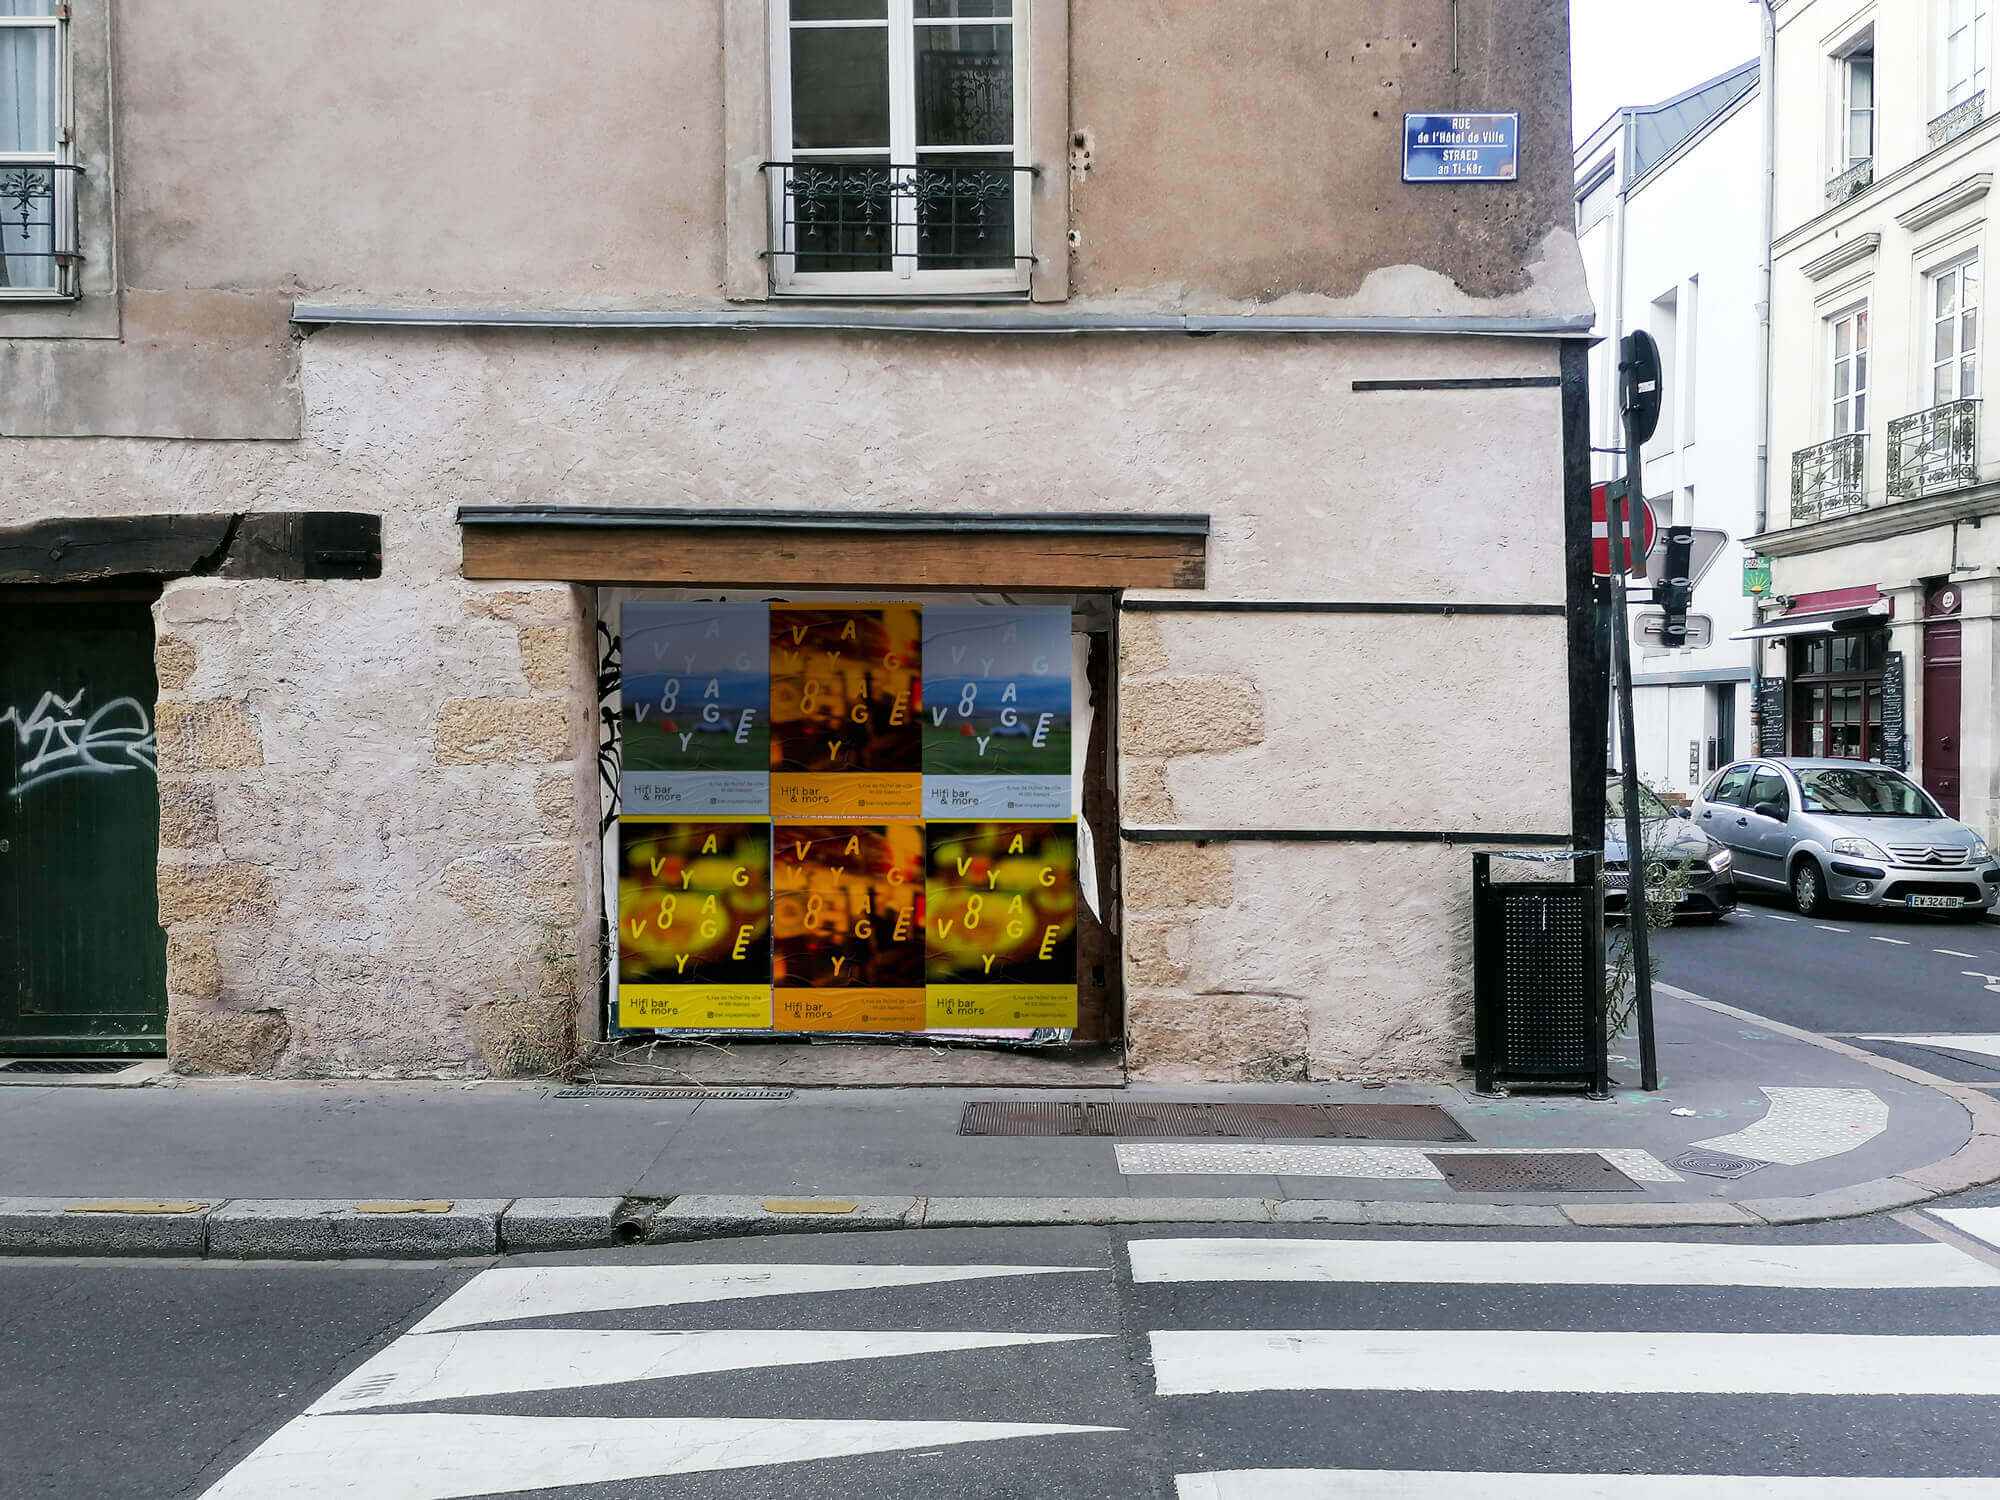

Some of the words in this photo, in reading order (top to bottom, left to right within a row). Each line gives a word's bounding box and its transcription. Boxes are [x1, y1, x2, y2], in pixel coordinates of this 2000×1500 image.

[1452, 118, 1471, 130] RUE
[1418, 132, 1429, 143] de
[1468, 132, 1479, 143] de
[1483, 132, 1504, 143] Ville
[1443, 150, 1478, 161] STRAED
[1438, 165, 1448, 174] an
[634, 784, 651, 794] Hifi
[655, 784, 672, 794] bar
[781, 786, 798, 796] Hifi
[802, 786, 820, 796] bar
[932, 789, 948, 798] Hifi
[952, 789, 969, 798] bar
[631, 999, 648, 1008] Hifi
[652, 999, 669, 1008] bar
[785, 1002, 802, 1011] Hifi
[806, 1002, 823, 1011] bar
[937, 999, 954, 1008] Hifi
[958, 999, 975, 1008] bar
[794, 1010, 801, 1018] &
